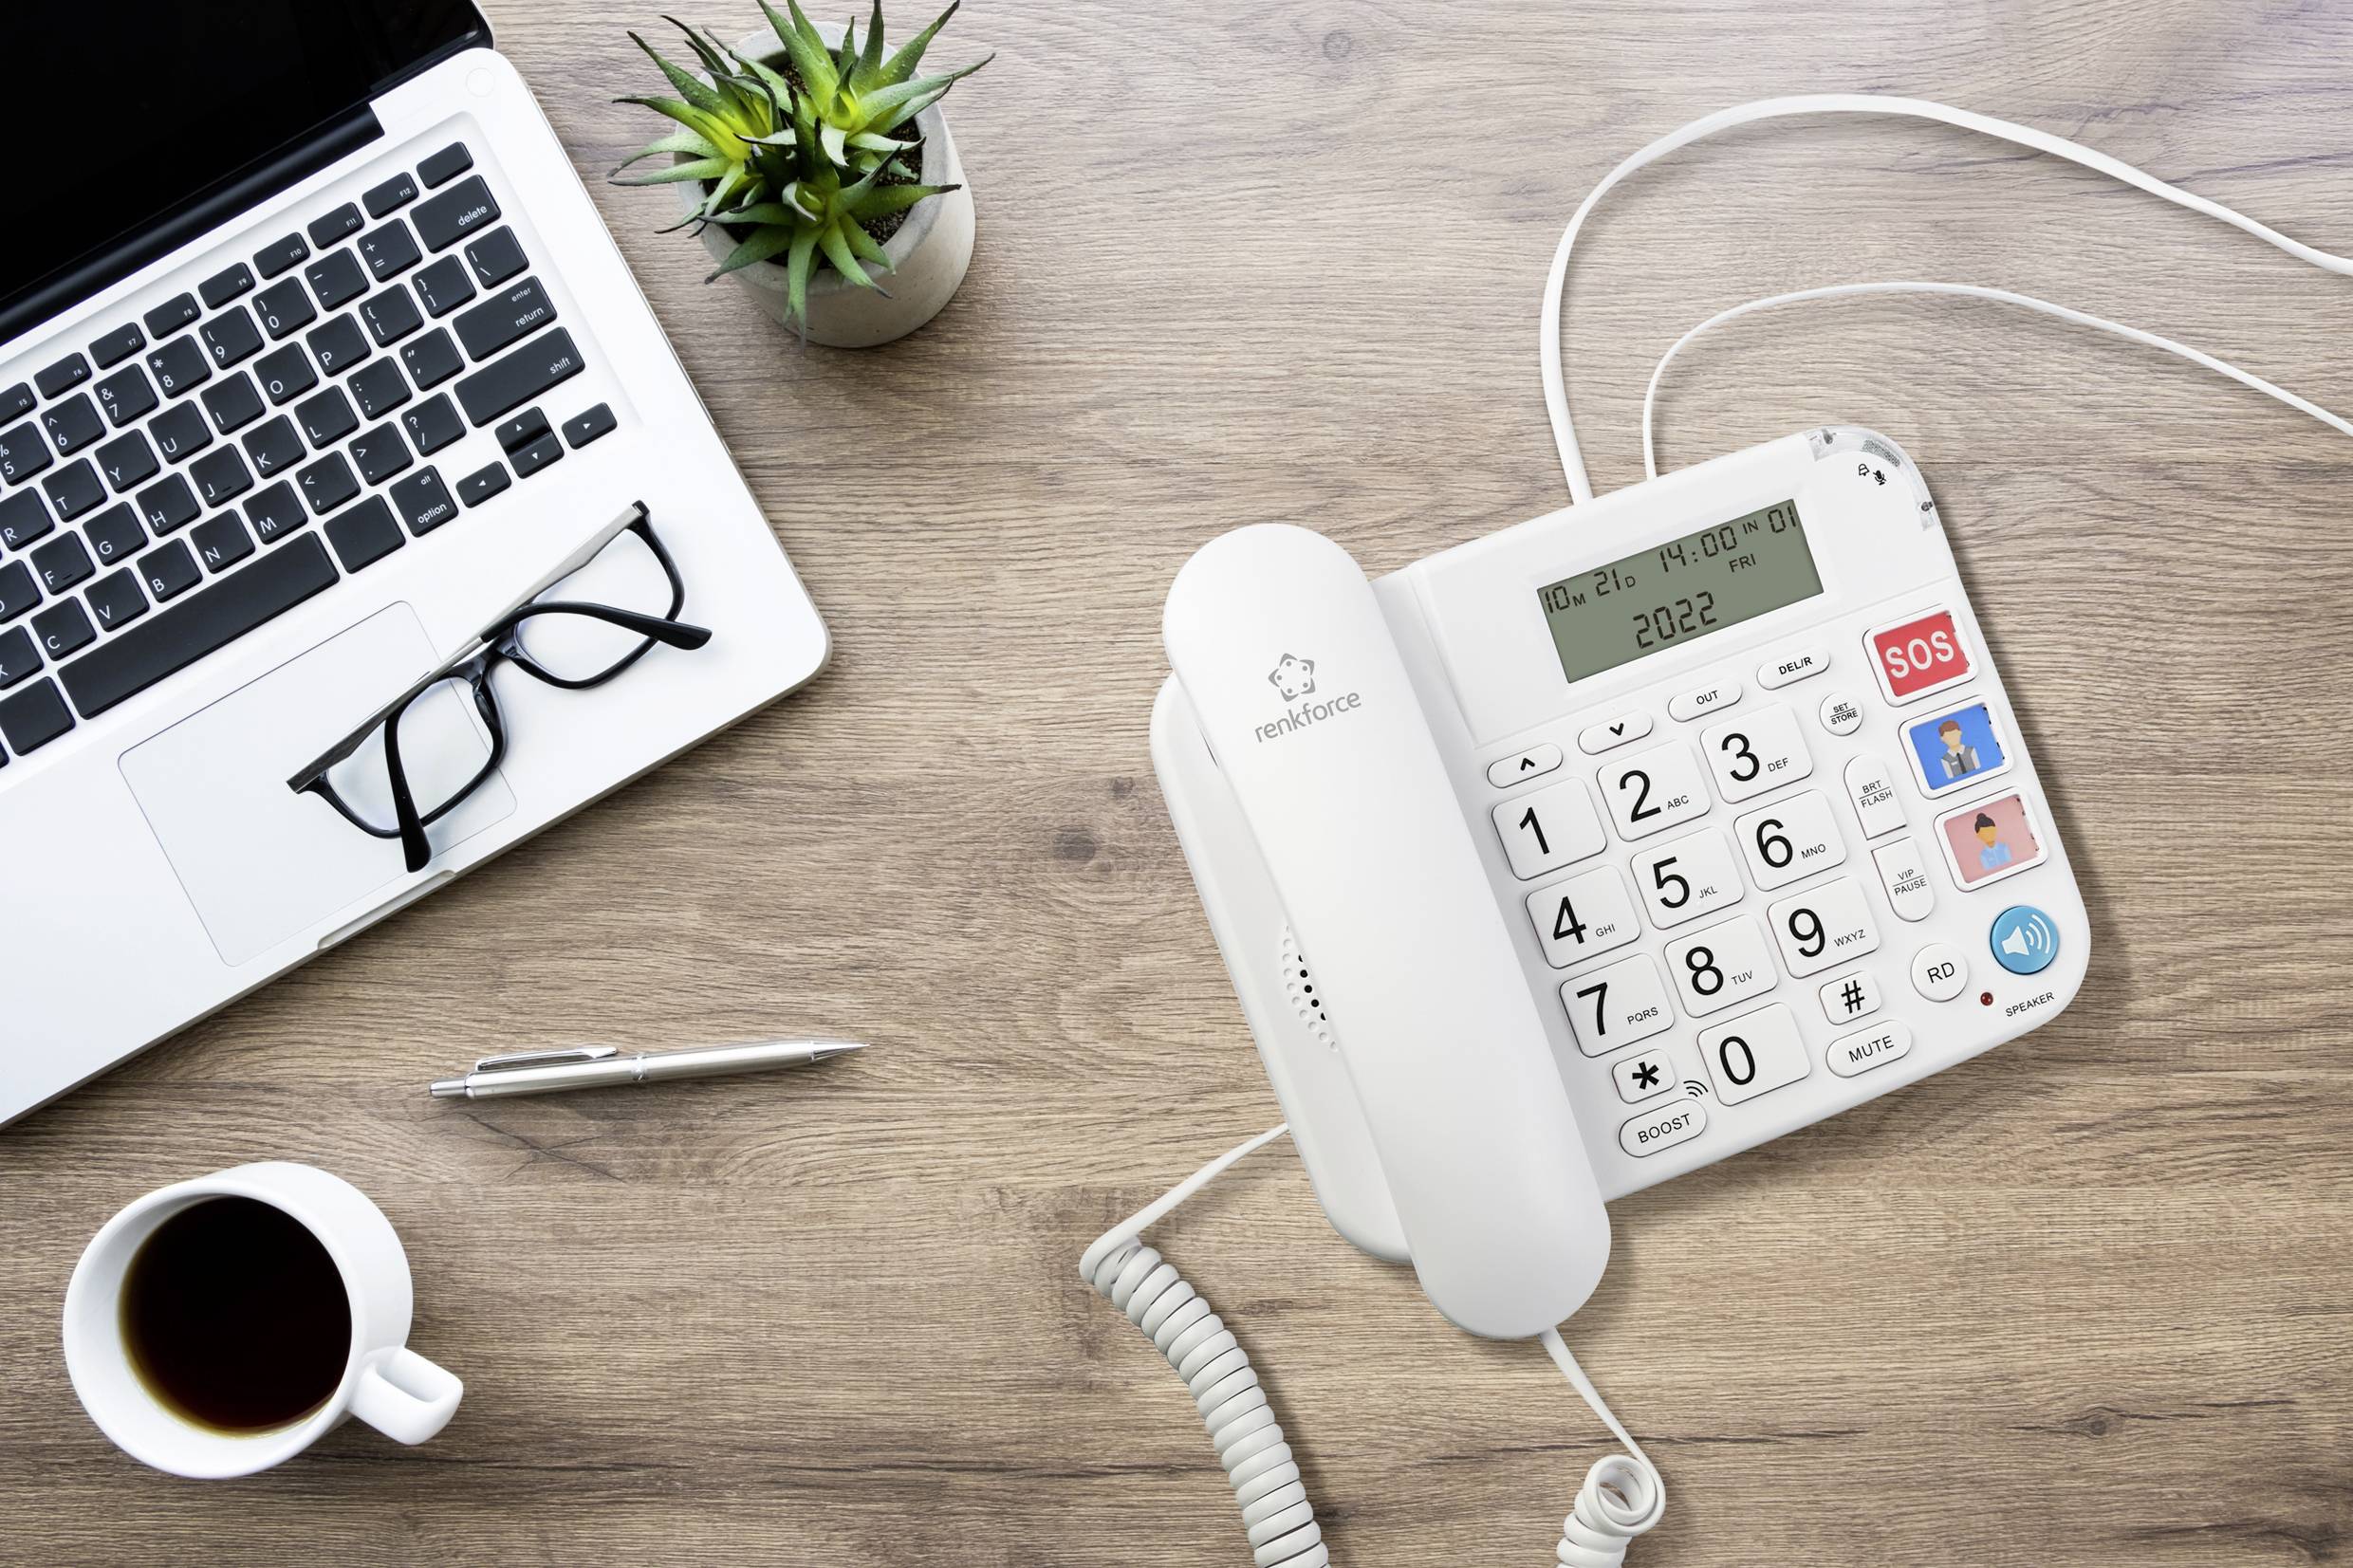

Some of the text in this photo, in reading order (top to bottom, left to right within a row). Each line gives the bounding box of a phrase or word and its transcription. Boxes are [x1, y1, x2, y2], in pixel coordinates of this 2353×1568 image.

[398, 187, 412, 197] F12
[344, 217, 358, 228] F11
[457, 205, 489, 228] delete
[289, 248, 303, 259] F10
[365, 243, 376, 252] +
[374, 258, 385, 268] =
[237, 277, 248, 287] F9
[510, 286, 532, 303] enter
[183, 307, 194, 318] F8
[514, 305, 545, 328] return
[128, 337, 137, 347] F7
[214, 345, 226, 360] 9
[321, 351, 333, 366] P
[73, 368, 83, 377] F6
[549, 356, 572, 376] shift
[162, 375, 175, 388] 8
[269, 379, 284, 395] O
[19, 398, 28, 407] F5
[101, 388, 115, 401] &
[108, 403, 119, 418] 7
[409, 415, 418, 428] ?
[57, 433, 68, 447] 6
[308, 426, 323, 439] L
[162, 437, 177, 453] U
[4, 460, 15, 475] 5
[256, 452, 272, 469] K
[108, 467, 121, 482] Y
[420, 474, 432, 486] alt
[207, 483, 216, 498] J
[56, 496, 68, 511] T
[150, 510, 167, 527] H
[417, 502, 448, 525] option
[259, 516, 278, 534] M
[4, 526, 18, 543] R
[1660, 526, 1738, 574] 14:00
[1742, 519, 1759, 536] IN
[1768, 506, 1797, 534] 01
[99, 540, 113, 555] G
[204, 546, 221, 563] N
[1729, 554, 1755, 572] FRI
[44, 570, 54, 585] F
[151, 578, 165, 593] B
[98, 604, 111, 620] V
[1633, 592, 1716, 649] 2022
[46, 635, 61, 650] C
[1884, 630, 1955, 679] SOS
[1778, 656, 1813, 676] DEL/R
[1696, 691, 1717, 705] OUT
[1833, 703, 1849, 714] SET
[1254, 692, 1362, 743] renkforce
[1830, 710, 1859, 726] STORE
[1722, 733, 1788, 782] 3 DEF
[1862, 780, 1882, 795] BRT
[1620, 770, 1689, 822] 2 ABC
[1861, 789, 1894, 808] FLASH
[1519, 807, 1549, 855] 1
[1756, 819, 1825, 868] 6 MNO
[1653, 857, 1717, 908] 5 JKL
[1898, 868, 1915, 882] VIP
[1894, 877, 1927, 896] PAUSE
[1553, 896, 1615, 944] 4 GHI
[1788, 909, 1865, 957] 9 WXYZ
[1686, 947, 1751, 995] 8 TUV
[1927, 963, 1955, 983] RD
[1841, 980, 1865, 1014] #
[2005, 991, 2055, 1018] SPEAKER
[1576, 982, 1658, 1036] 7 PQRS
[1848, 1035, 1895, 1062] MUTE
[1719, 1036, 1755, 1085] 0
[1637, 1113, 1692, 1144] BOOST
